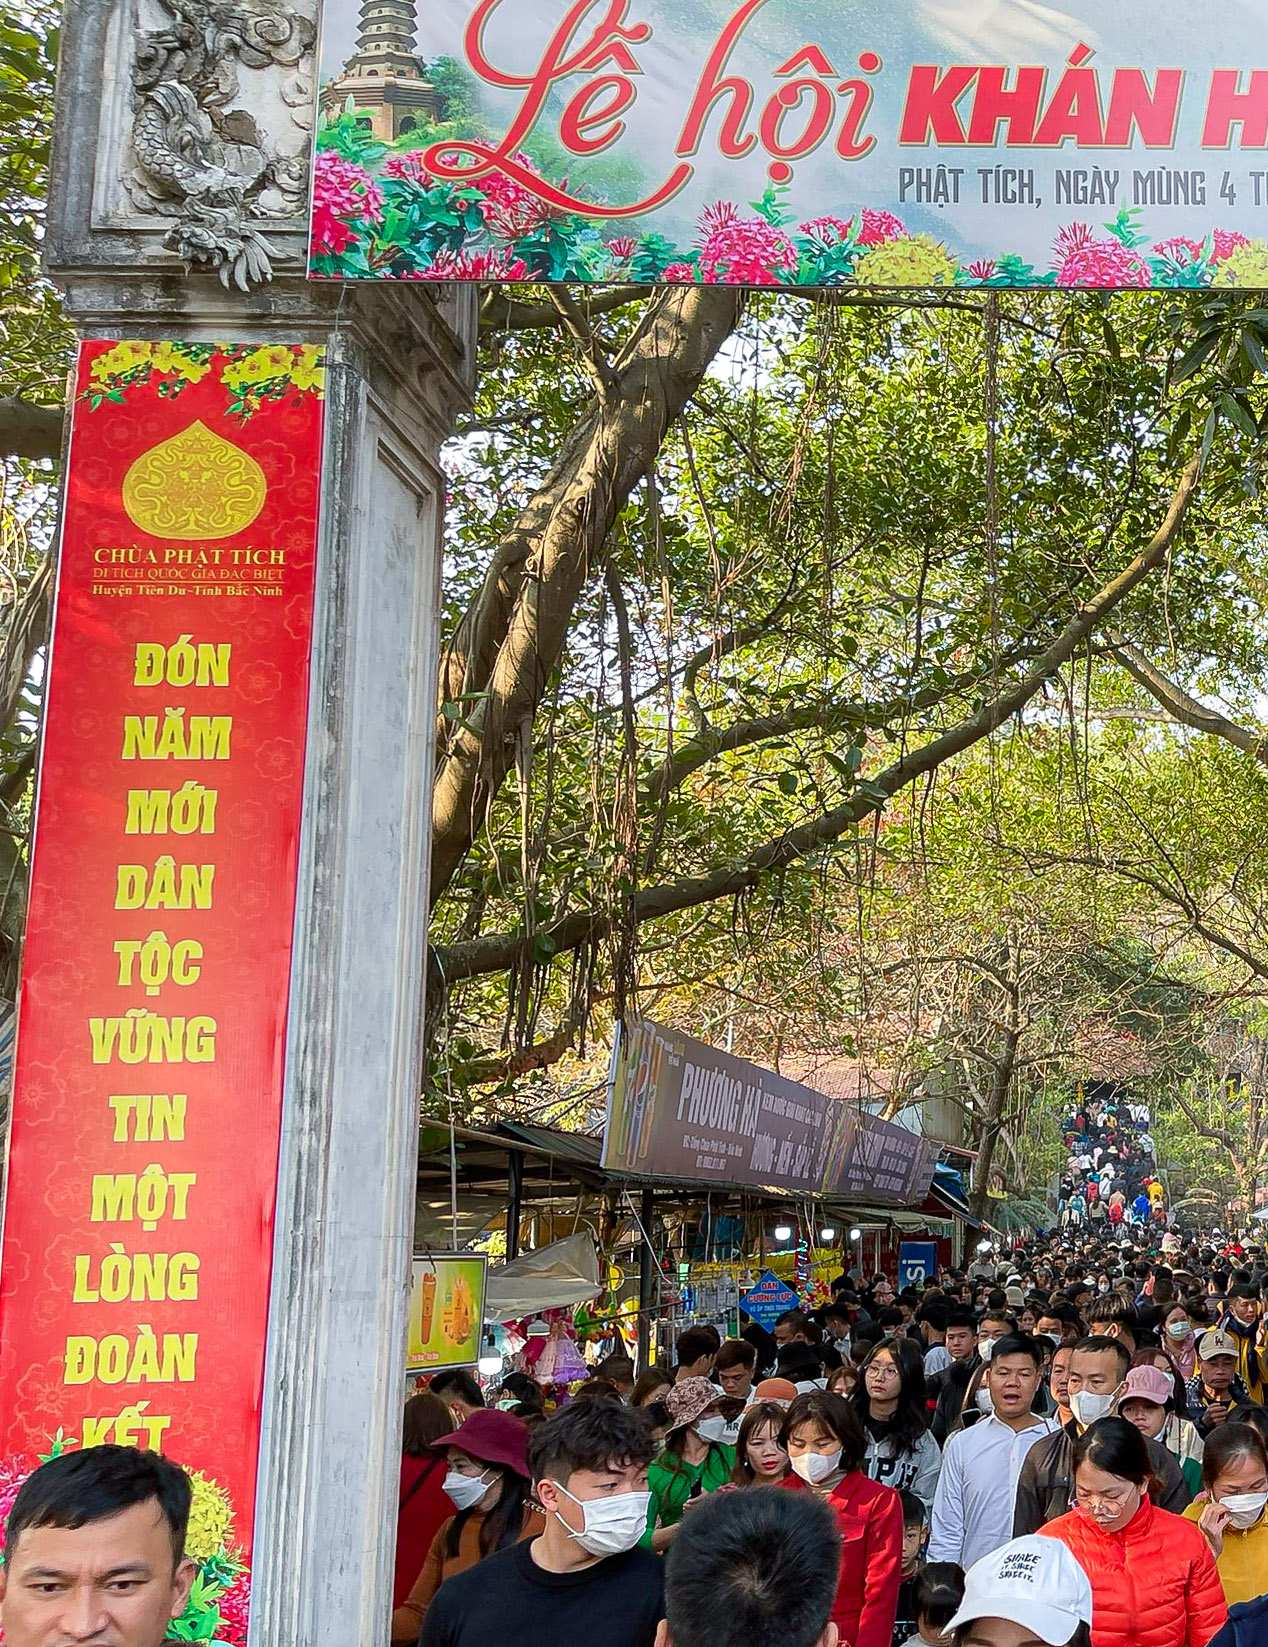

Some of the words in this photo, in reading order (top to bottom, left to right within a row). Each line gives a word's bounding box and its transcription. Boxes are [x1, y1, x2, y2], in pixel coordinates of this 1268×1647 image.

[674, 0, 882, 184] hội
[897, 40, 1186, 149] KHÁN
[899, 163, 965, 208] PHẬT
[976, 164, 1042, 208] TÍCH,
[1056, 165, 1120, 205] NGÀY
[1132, 165, 1206, 206] MÙNG
[1219, 171, 1237, 206] 4
[94, 543, 157, 564] CHÙA
[164, 545, 224, 568] PHẬT
[231, 545, 286, 565] TÍCH
[133, 634, 233, 688] ĐÓN
[121, 706, 234, 761] NĂM
[124, 780, 219, 836] MỚI
[114, 854, 216, 912] DÂN
[113, 929, 205, 997] TỘC
[88, 1007, 217, 1065] VỮNG
[108, 1094, 188, 1142] TIN
[90, 1163, 197, 1233] MỘT
[72, 1250, 200, 1303] LÒNG
[64, 1332, 199, 1386] ĐOÀN
